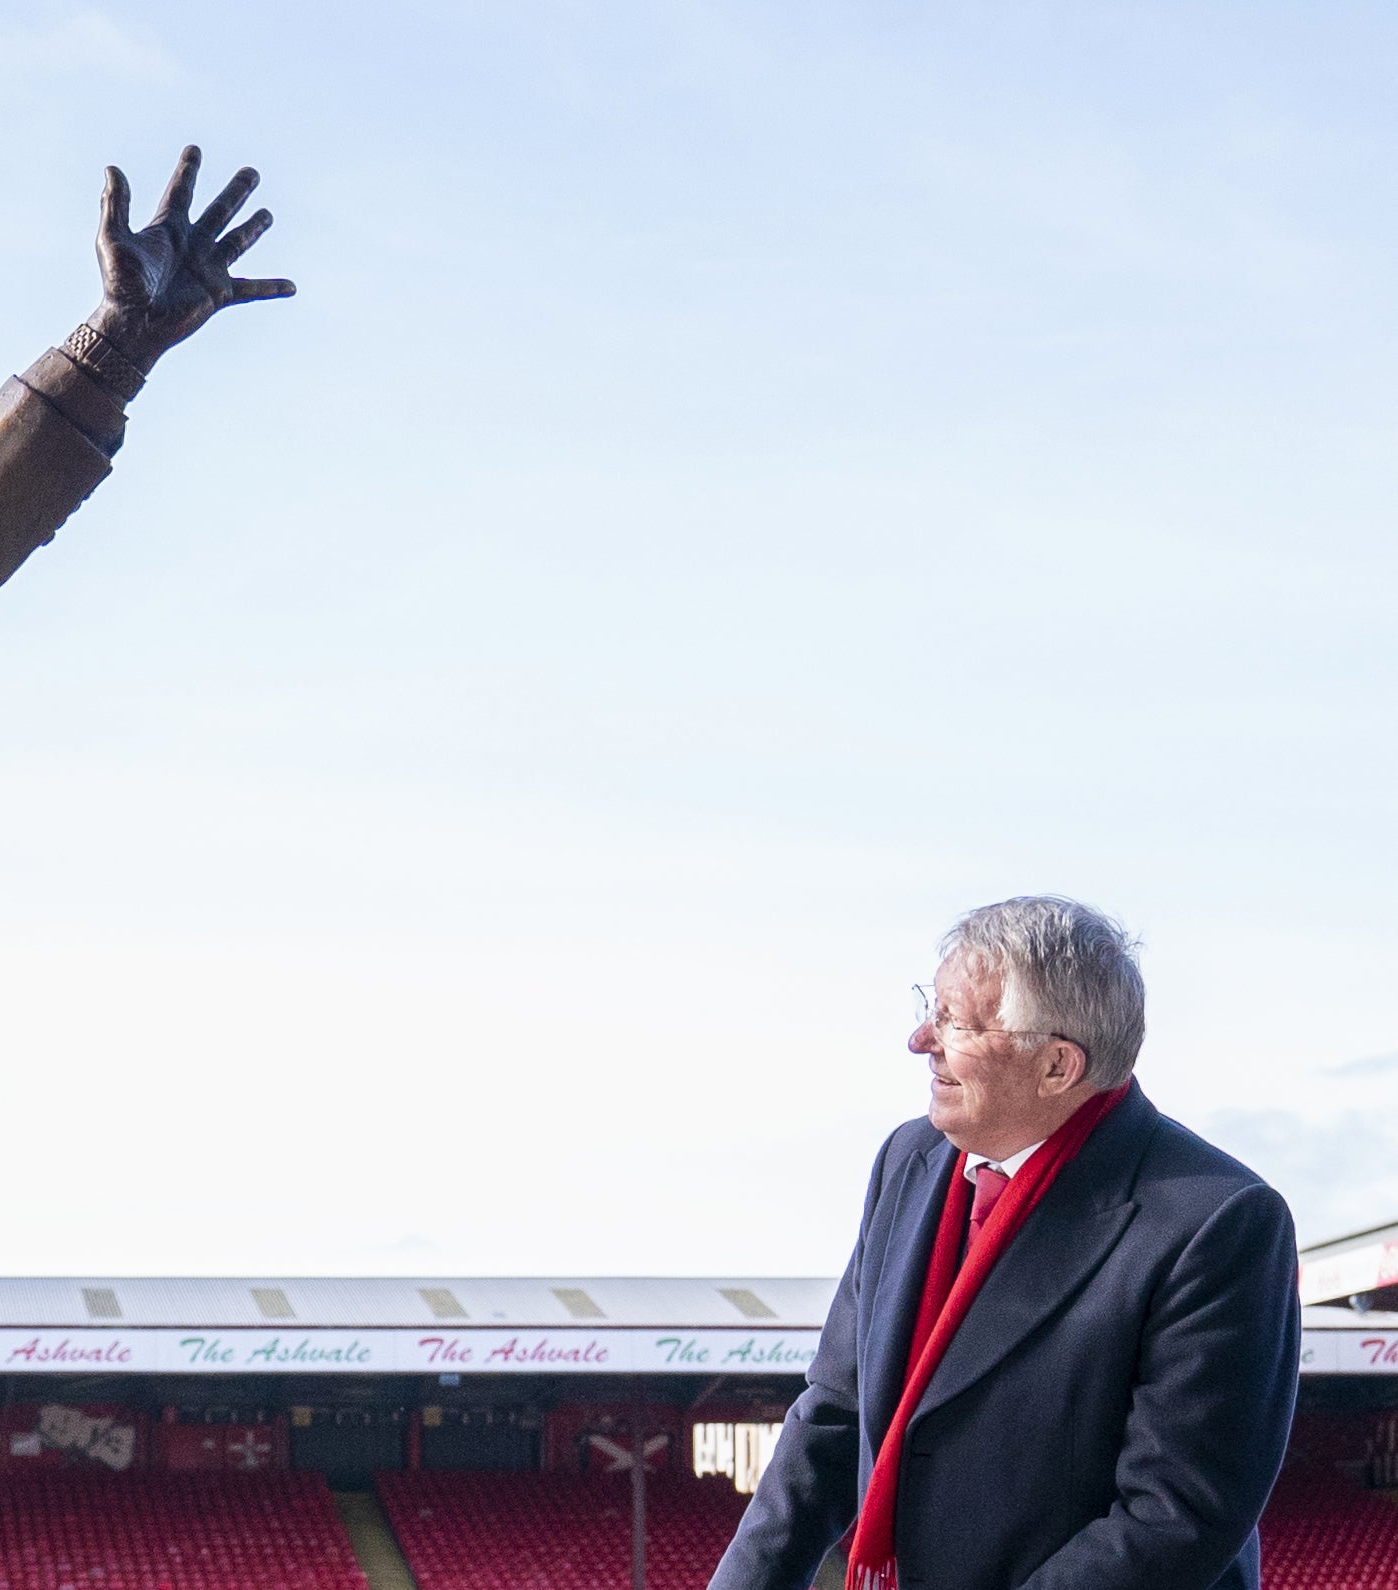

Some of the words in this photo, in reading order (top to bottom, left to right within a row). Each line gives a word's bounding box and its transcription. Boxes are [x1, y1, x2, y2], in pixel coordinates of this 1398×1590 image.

[6, 1337, 132, 1363] Ashvale
[180, 1338, 235, 1363] The
[245, 1337, 370, 1363] Ashvale
[419, 1338, 474, 1363] The
[485, 1338, 610, 1363] Ashvale
[656, 1338, 711, 1364] The
